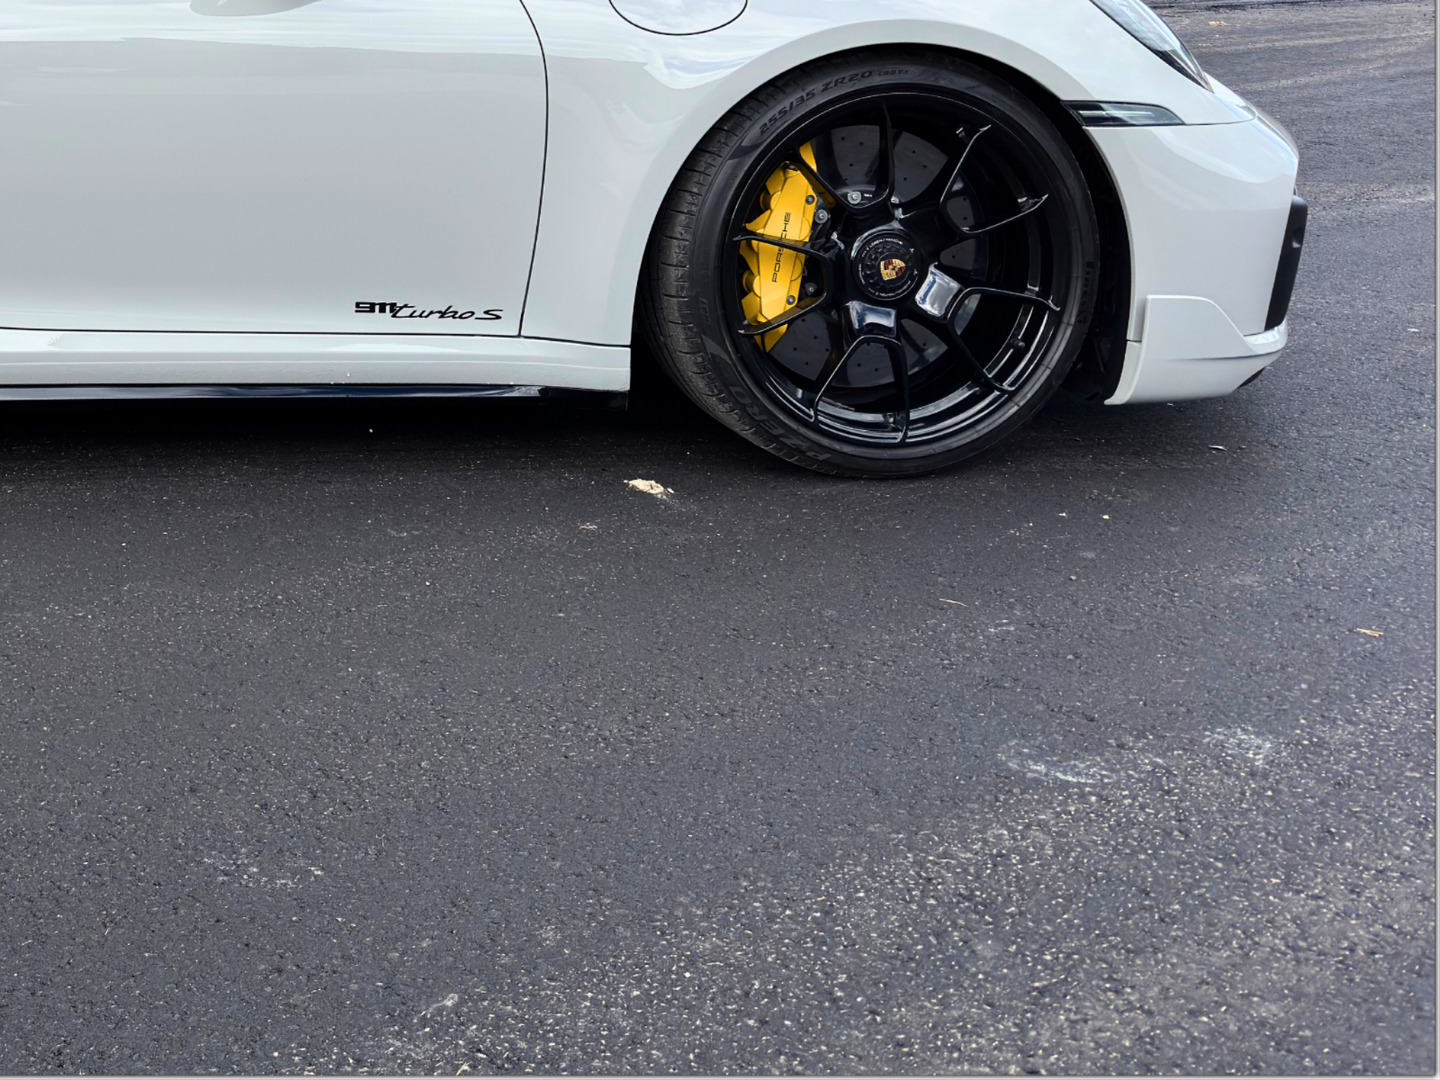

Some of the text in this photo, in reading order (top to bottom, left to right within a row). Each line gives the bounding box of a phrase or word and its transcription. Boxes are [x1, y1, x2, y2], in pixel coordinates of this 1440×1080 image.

[759, 88, 817, 136] 255/35
[821, 70, 873, 93] ZR20
[355, 301, 504, 320] 911 turbo S
